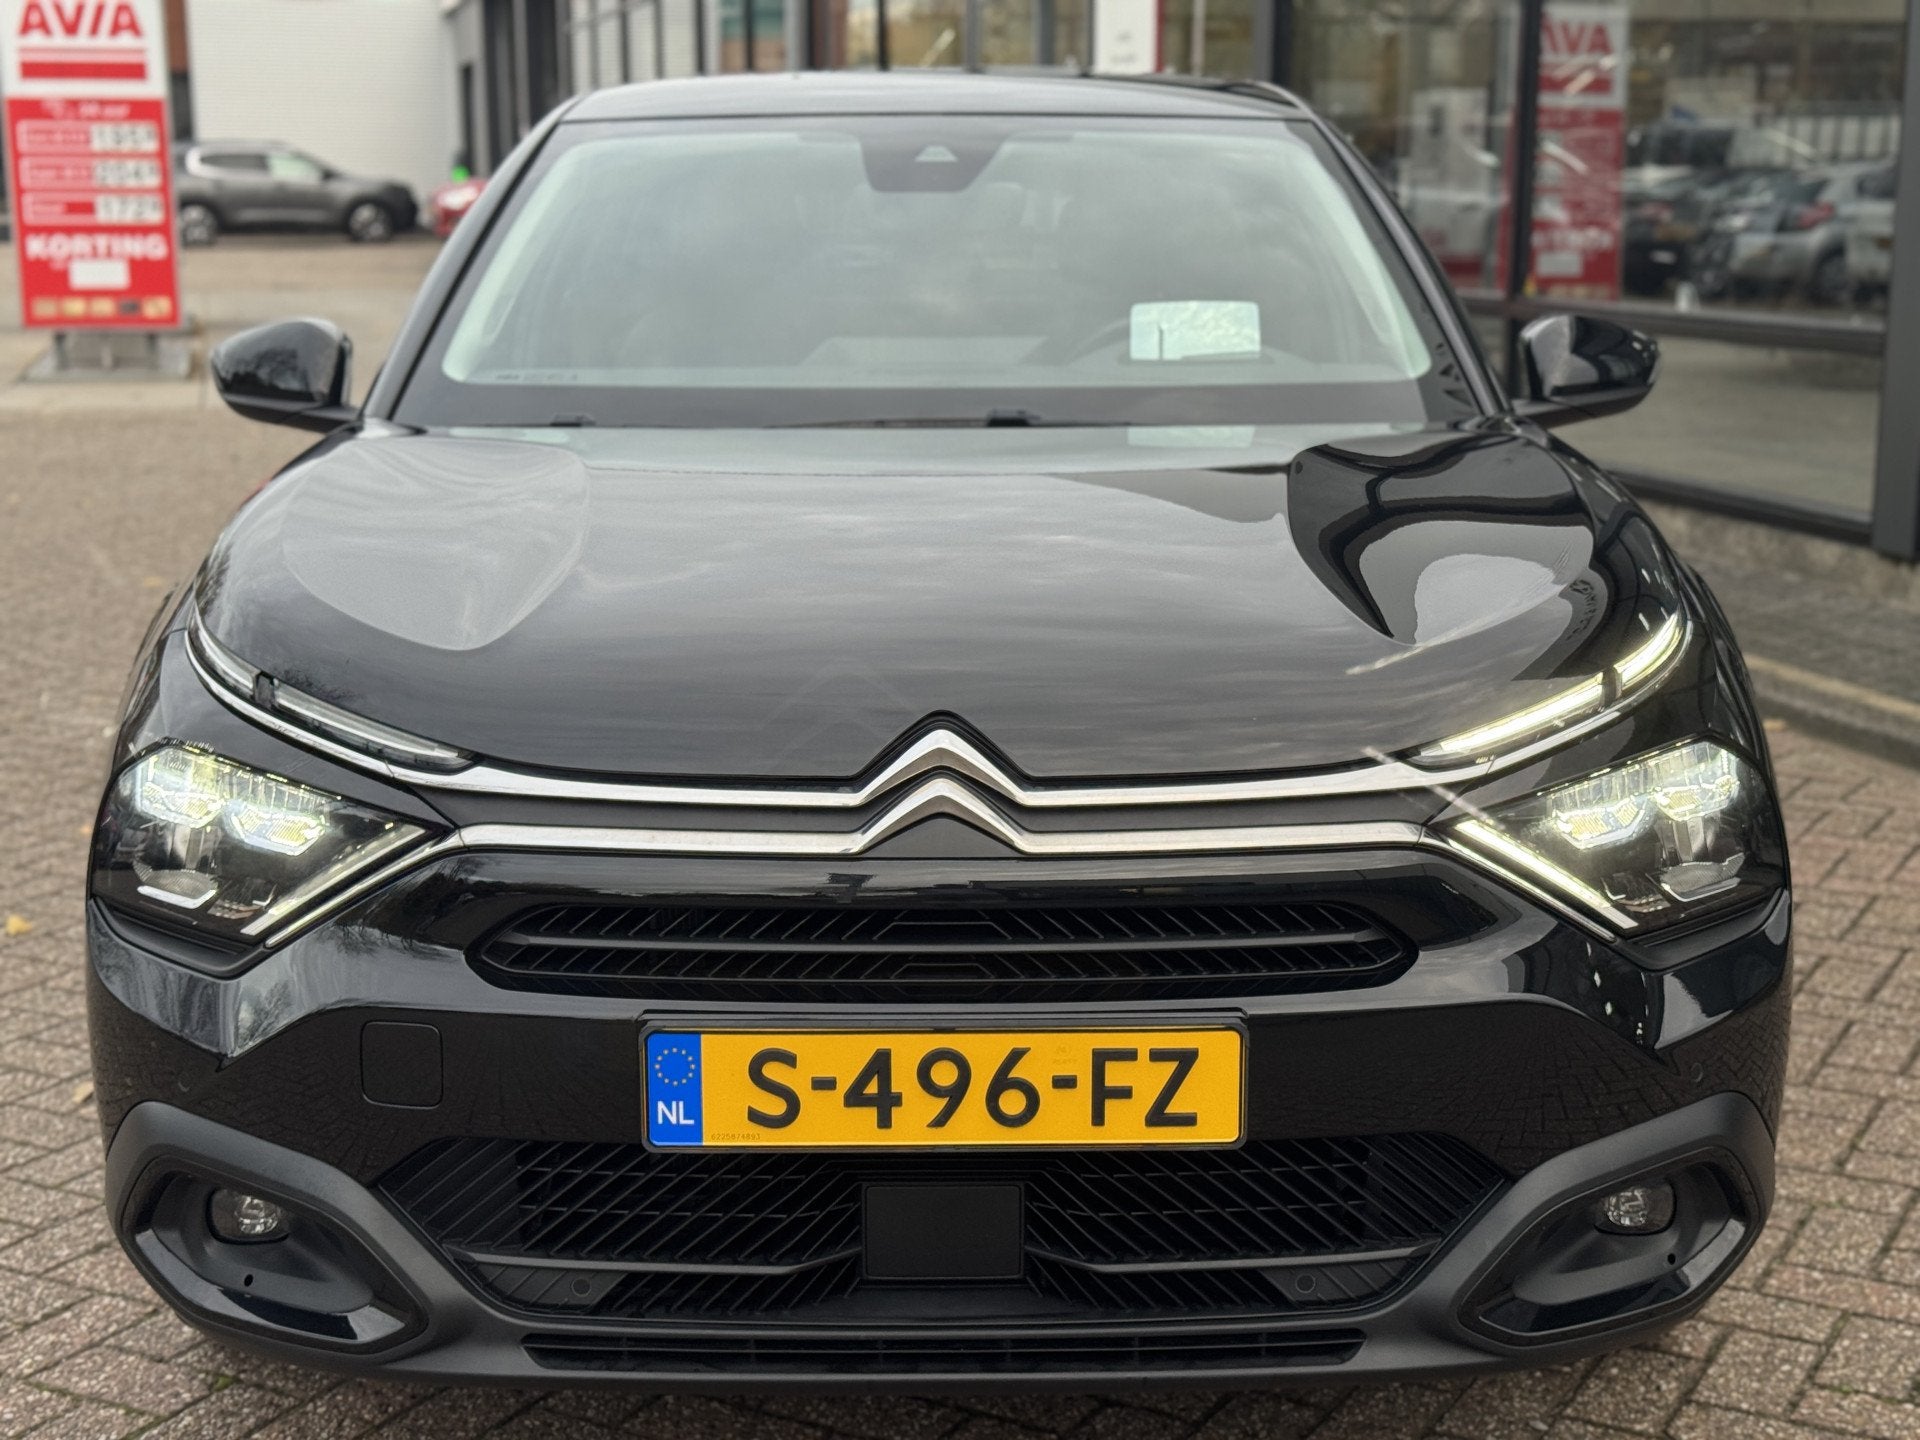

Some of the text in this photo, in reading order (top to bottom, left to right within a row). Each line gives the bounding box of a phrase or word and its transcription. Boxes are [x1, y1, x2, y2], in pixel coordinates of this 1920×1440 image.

[18, 2, 143, 37] AVIA
[25, 233, 168, 261] KORTING
[746, 1047, 1200, 1129] S-496-FZ
[656, 1100, 695, 1125] NL
